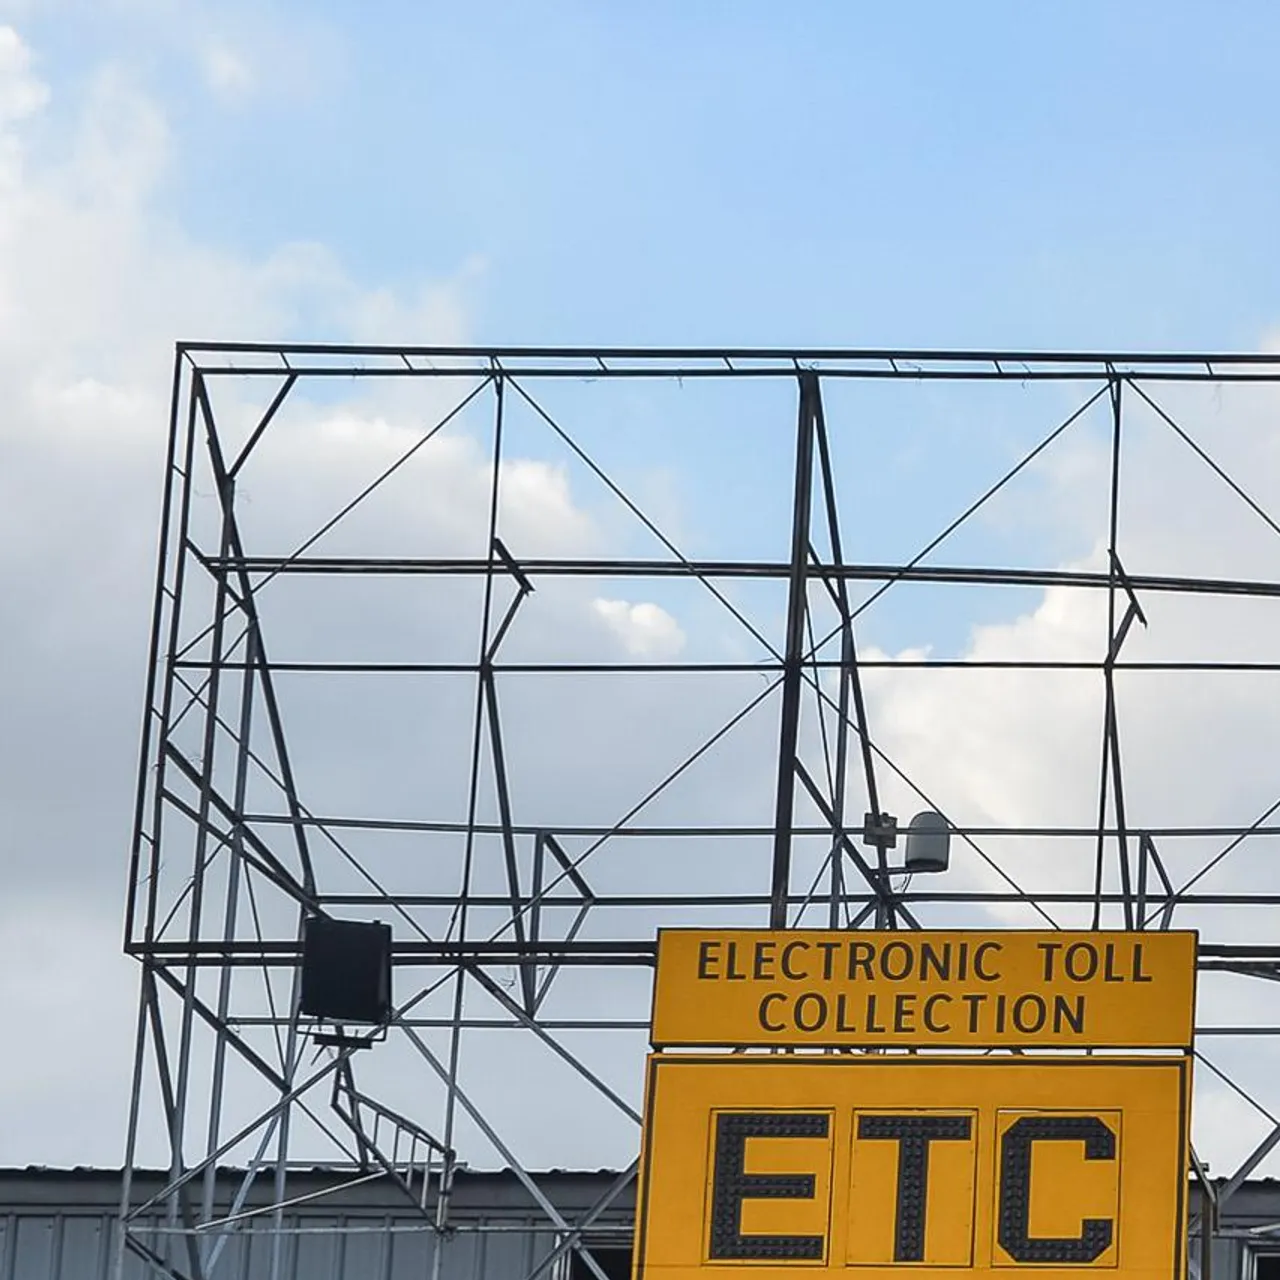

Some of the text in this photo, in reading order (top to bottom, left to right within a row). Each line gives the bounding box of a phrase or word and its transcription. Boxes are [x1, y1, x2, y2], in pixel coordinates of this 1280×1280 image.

[697, 941, 1153, 982] ELECTRONIC TOLL
[758, 993, 1085, 1033] COLLECTION
[709, 1113, 1116, 1263] ETC
